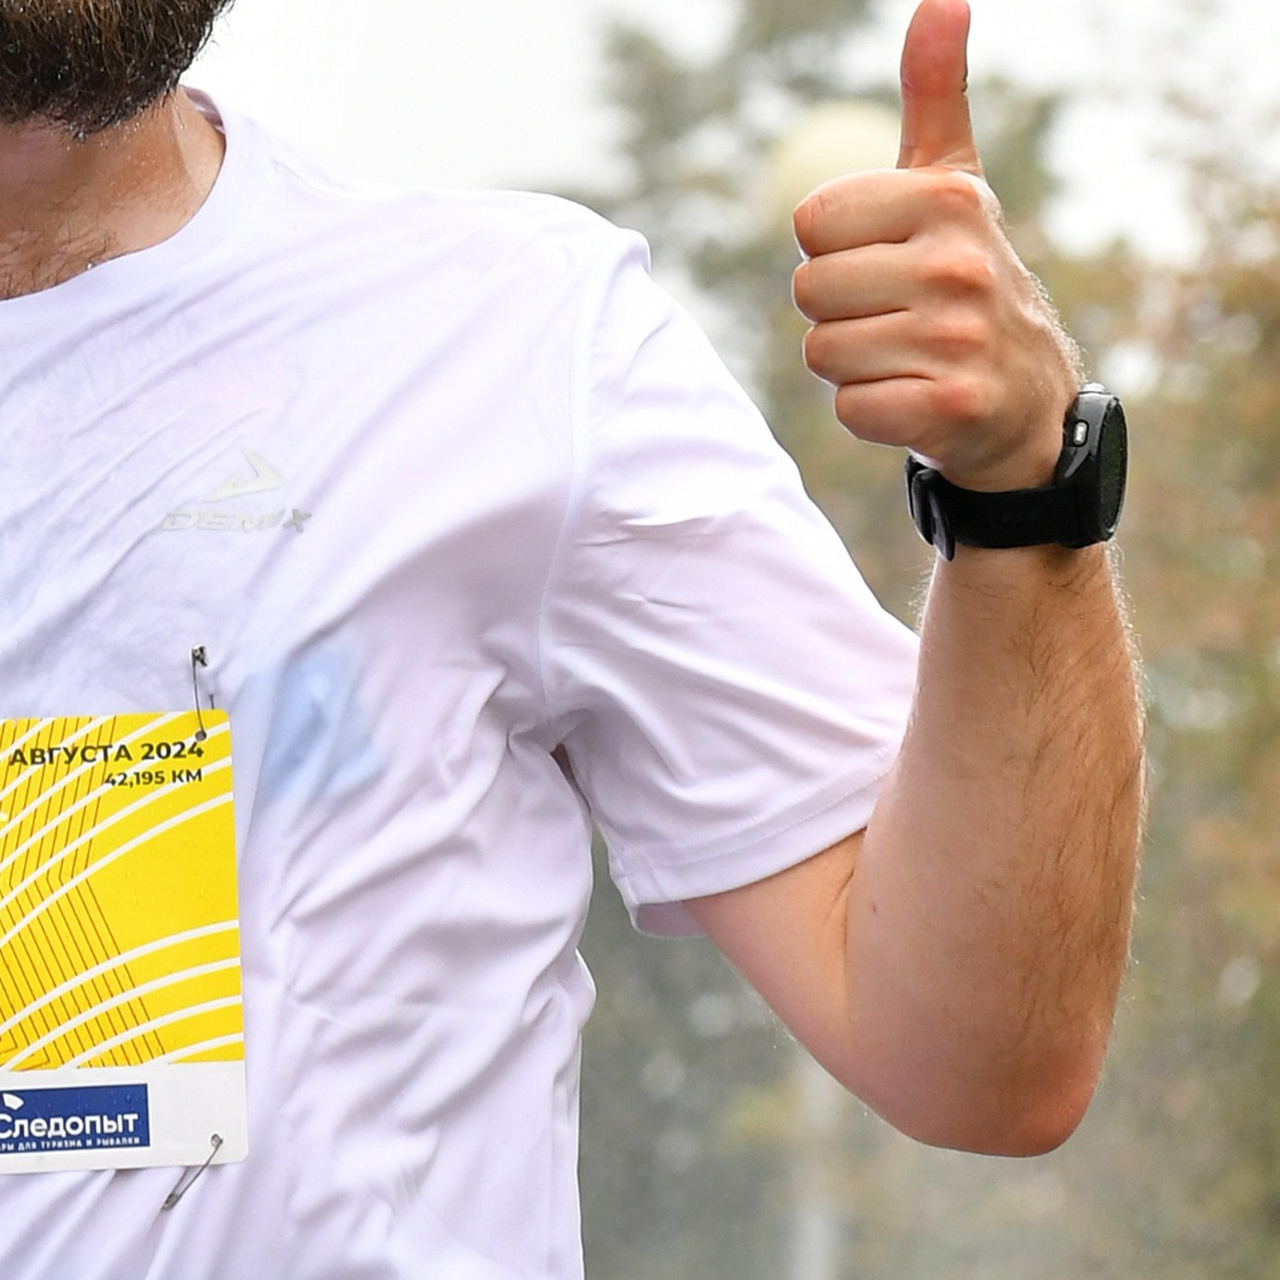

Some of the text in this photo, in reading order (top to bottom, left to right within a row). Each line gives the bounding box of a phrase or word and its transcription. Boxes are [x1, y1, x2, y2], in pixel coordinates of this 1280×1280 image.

[9, 744, 133, 766] АВГУСТА
[141, 741, 205, 761] 2024
[105, 768, 203, 789] 42,195 КМ
[18, 1141, 37, 1152] ДЛЯ
[41, 1139, 82, 1150] ТУРИЗМА
[85, 1139, 93, 1148] И
[96, 1136, 140, 1147] РЫБАЛКИ
